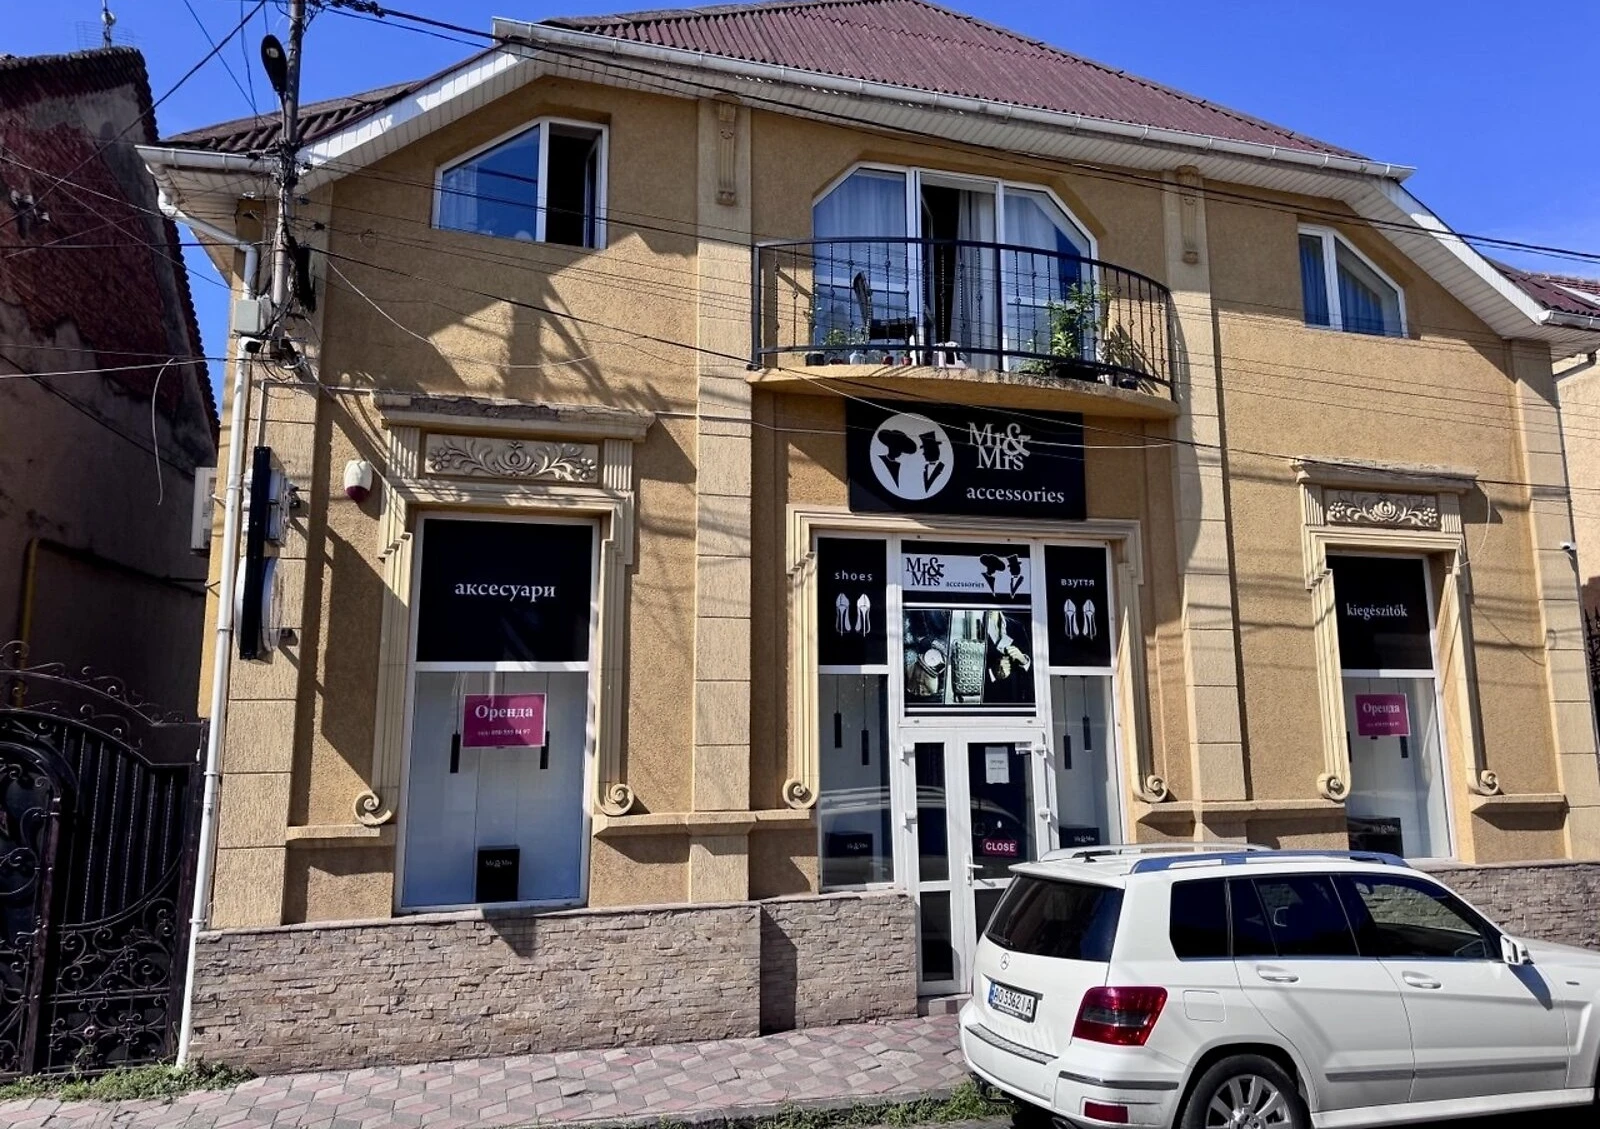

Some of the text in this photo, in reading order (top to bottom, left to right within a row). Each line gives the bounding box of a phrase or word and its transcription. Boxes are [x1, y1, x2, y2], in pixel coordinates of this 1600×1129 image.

[976, 446, 1024, 471] Mrs
[966, 486, 1065, 504] accessories
[834, 570, 873, 582] shoes
[1060, 577, 1095, 588] взуття
[454, 582, 556, 603] аксесуари
[475, 704, 534, 722] Оренда
[985, 842, 1016, 852] CLOSE
